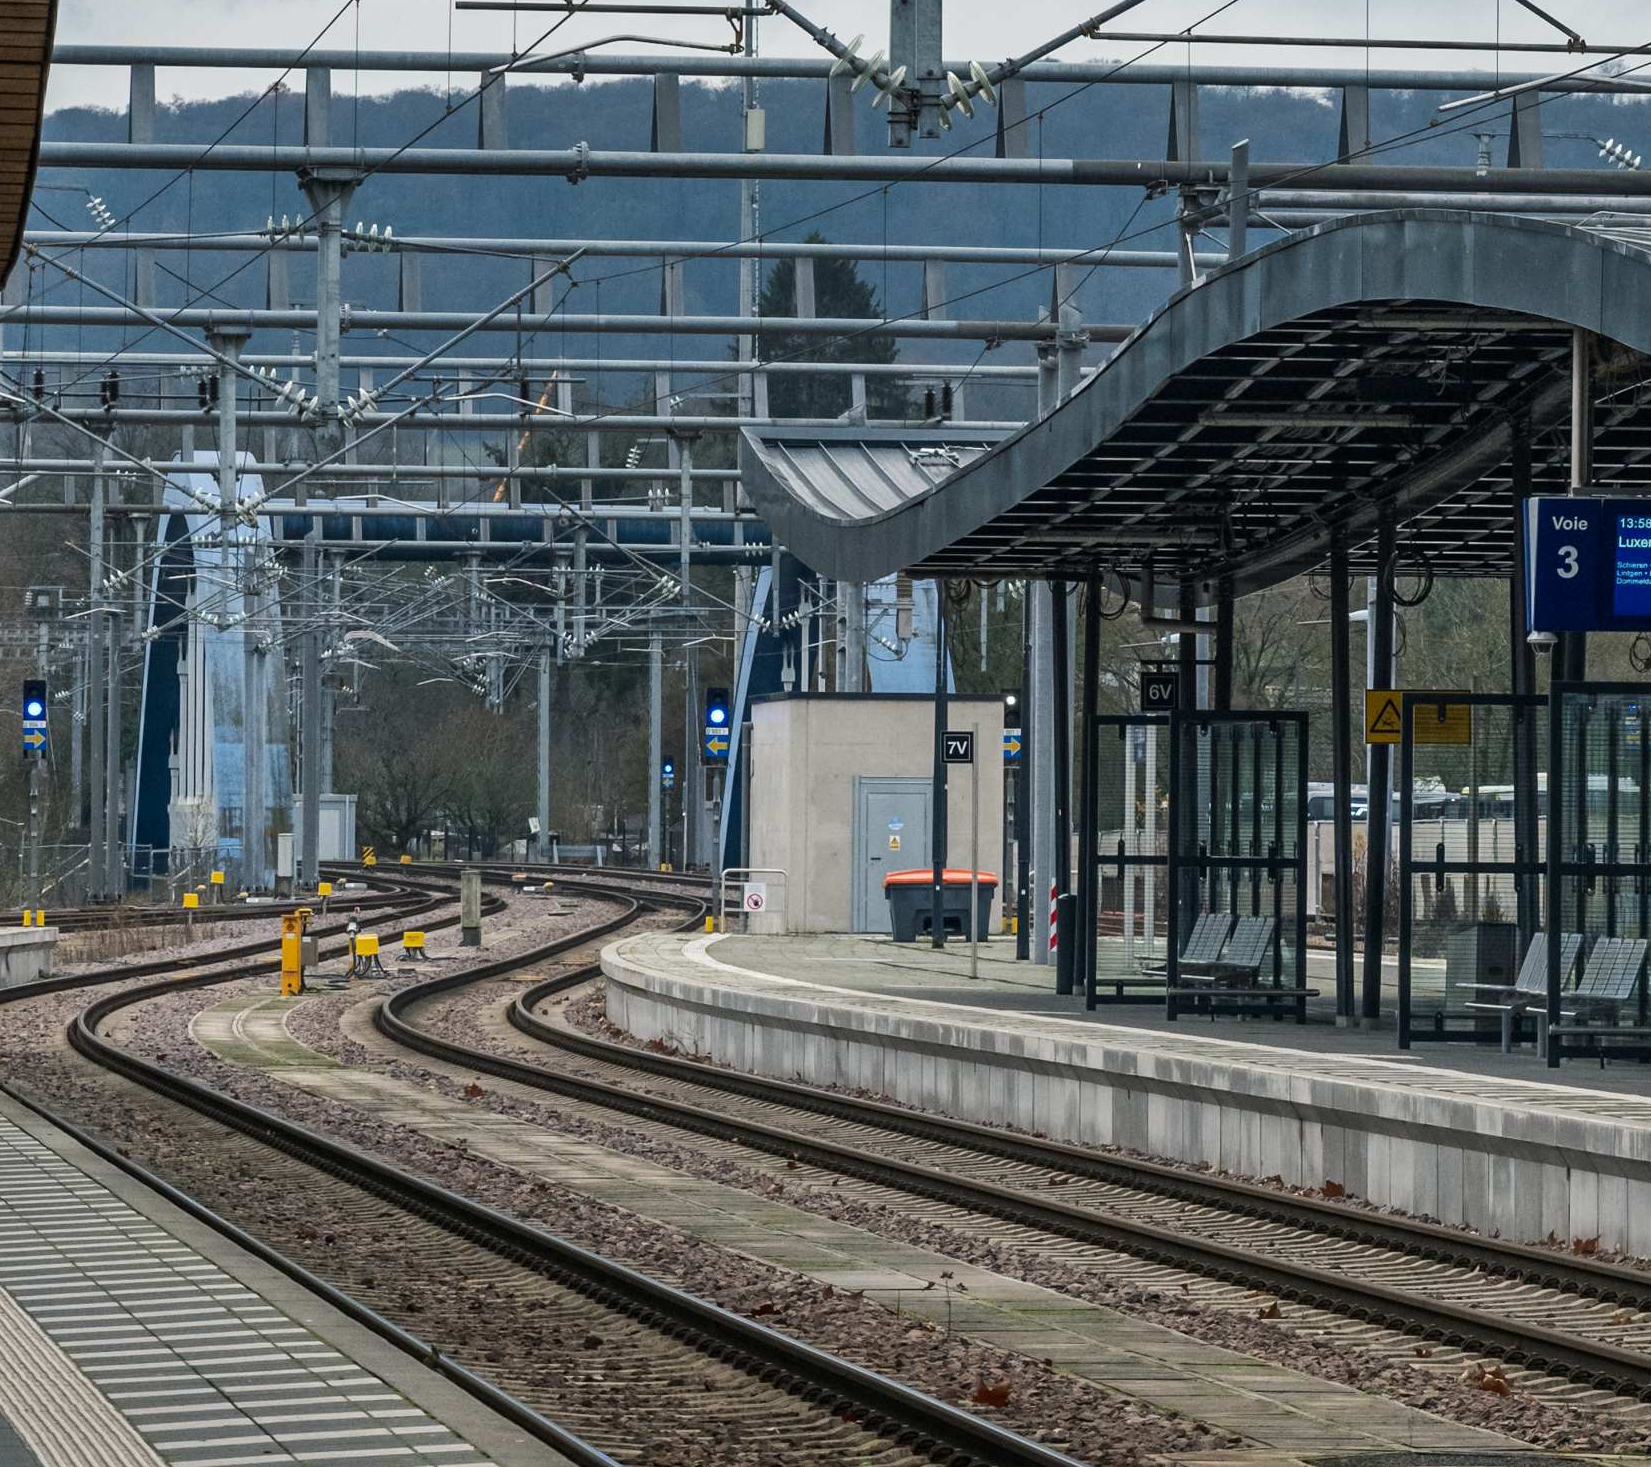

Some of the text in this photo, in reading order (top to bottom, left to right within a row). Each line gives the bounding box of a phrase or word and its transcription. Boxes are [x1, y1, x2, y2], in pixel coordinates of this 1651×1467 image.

[1551, 515, 1589, 531] Voie
[1556, 545, 1579, 579] 3
[1149, 683, 1172, 700] 6V
[947, 740, 968, 755] 7V
